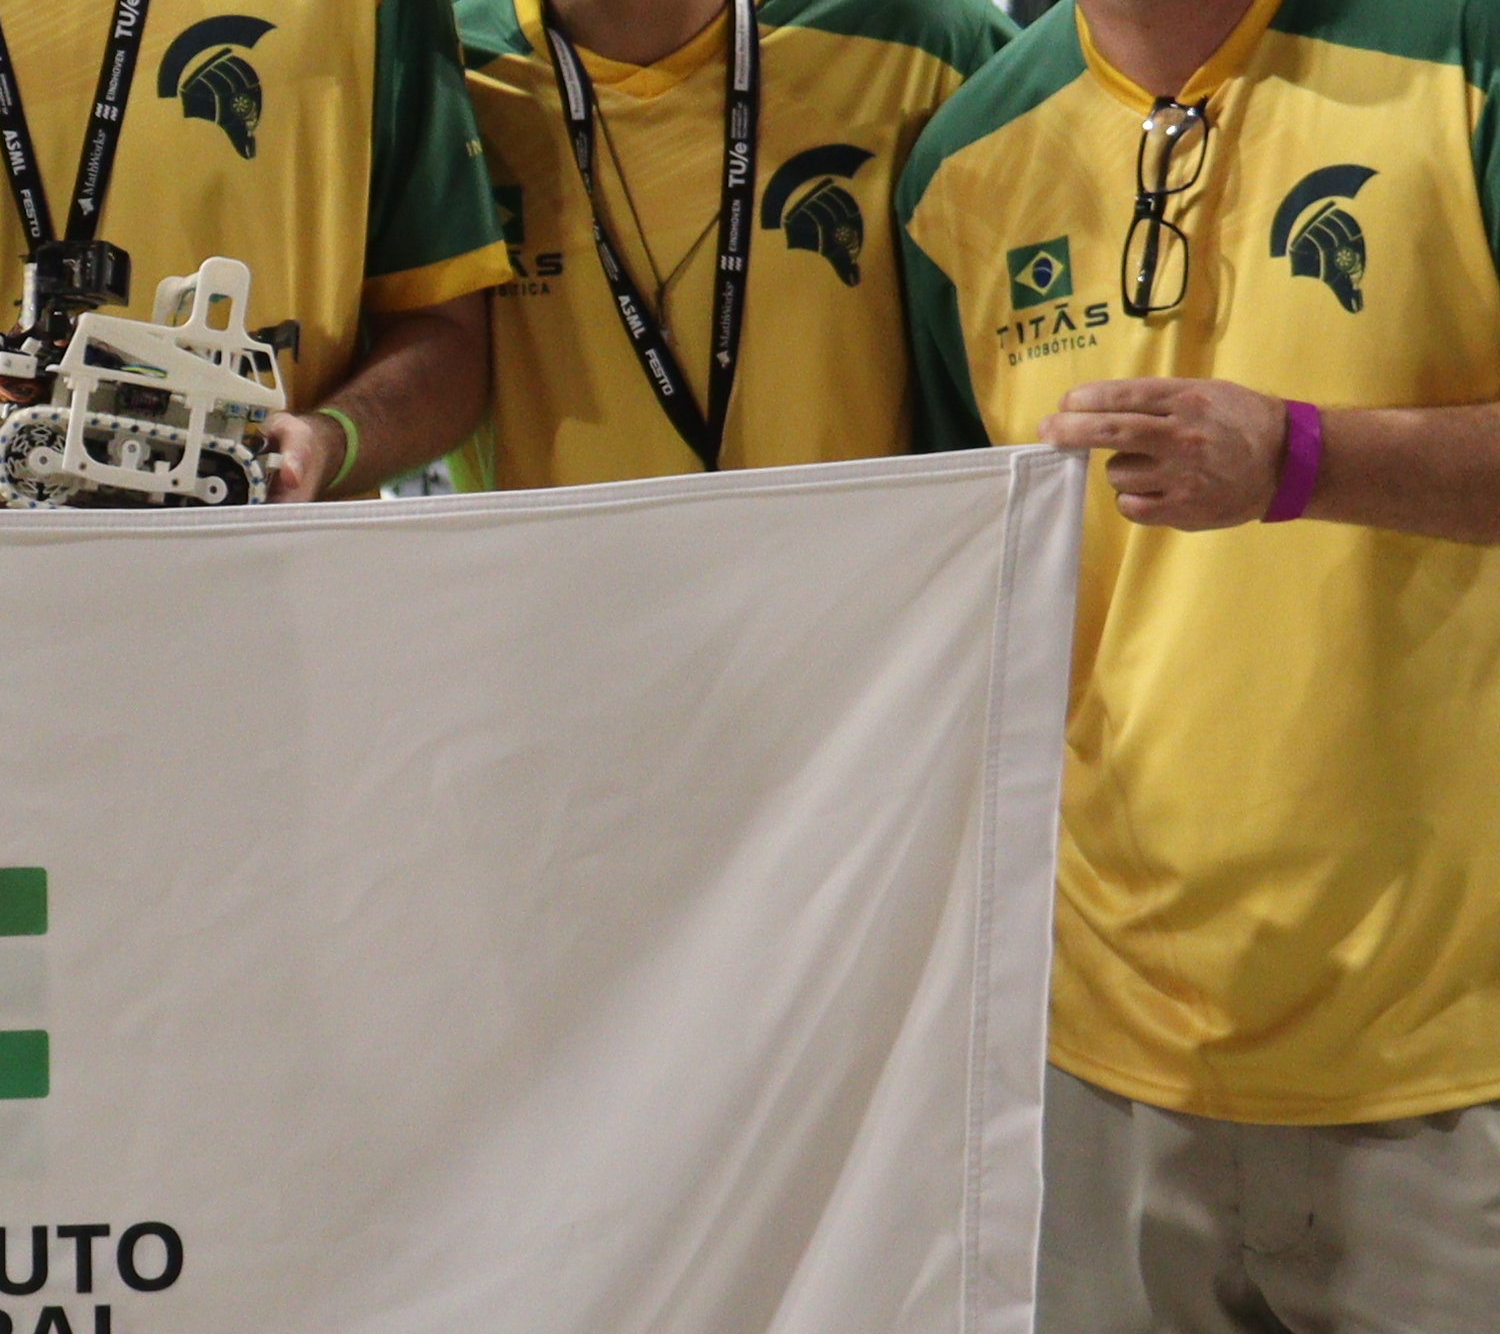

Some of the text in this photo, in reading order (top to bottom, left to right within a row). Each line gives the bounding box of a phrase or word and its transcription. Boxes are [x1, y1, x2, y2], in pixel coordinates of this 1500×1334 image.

[106, 49, 125, 102] EINDHOVEN
[2, 130, 27, 176] ASML
[728, 141, 748, 188] TU/e
[20, 189, 41, 238] FESTO
[618, 294, 647, 339] ASML
[996, 303, 1110, 350] TITÃS
[1026, 334, 1098, 361] ROBÓTICA
[645, 348, 675, 397] FESTO
